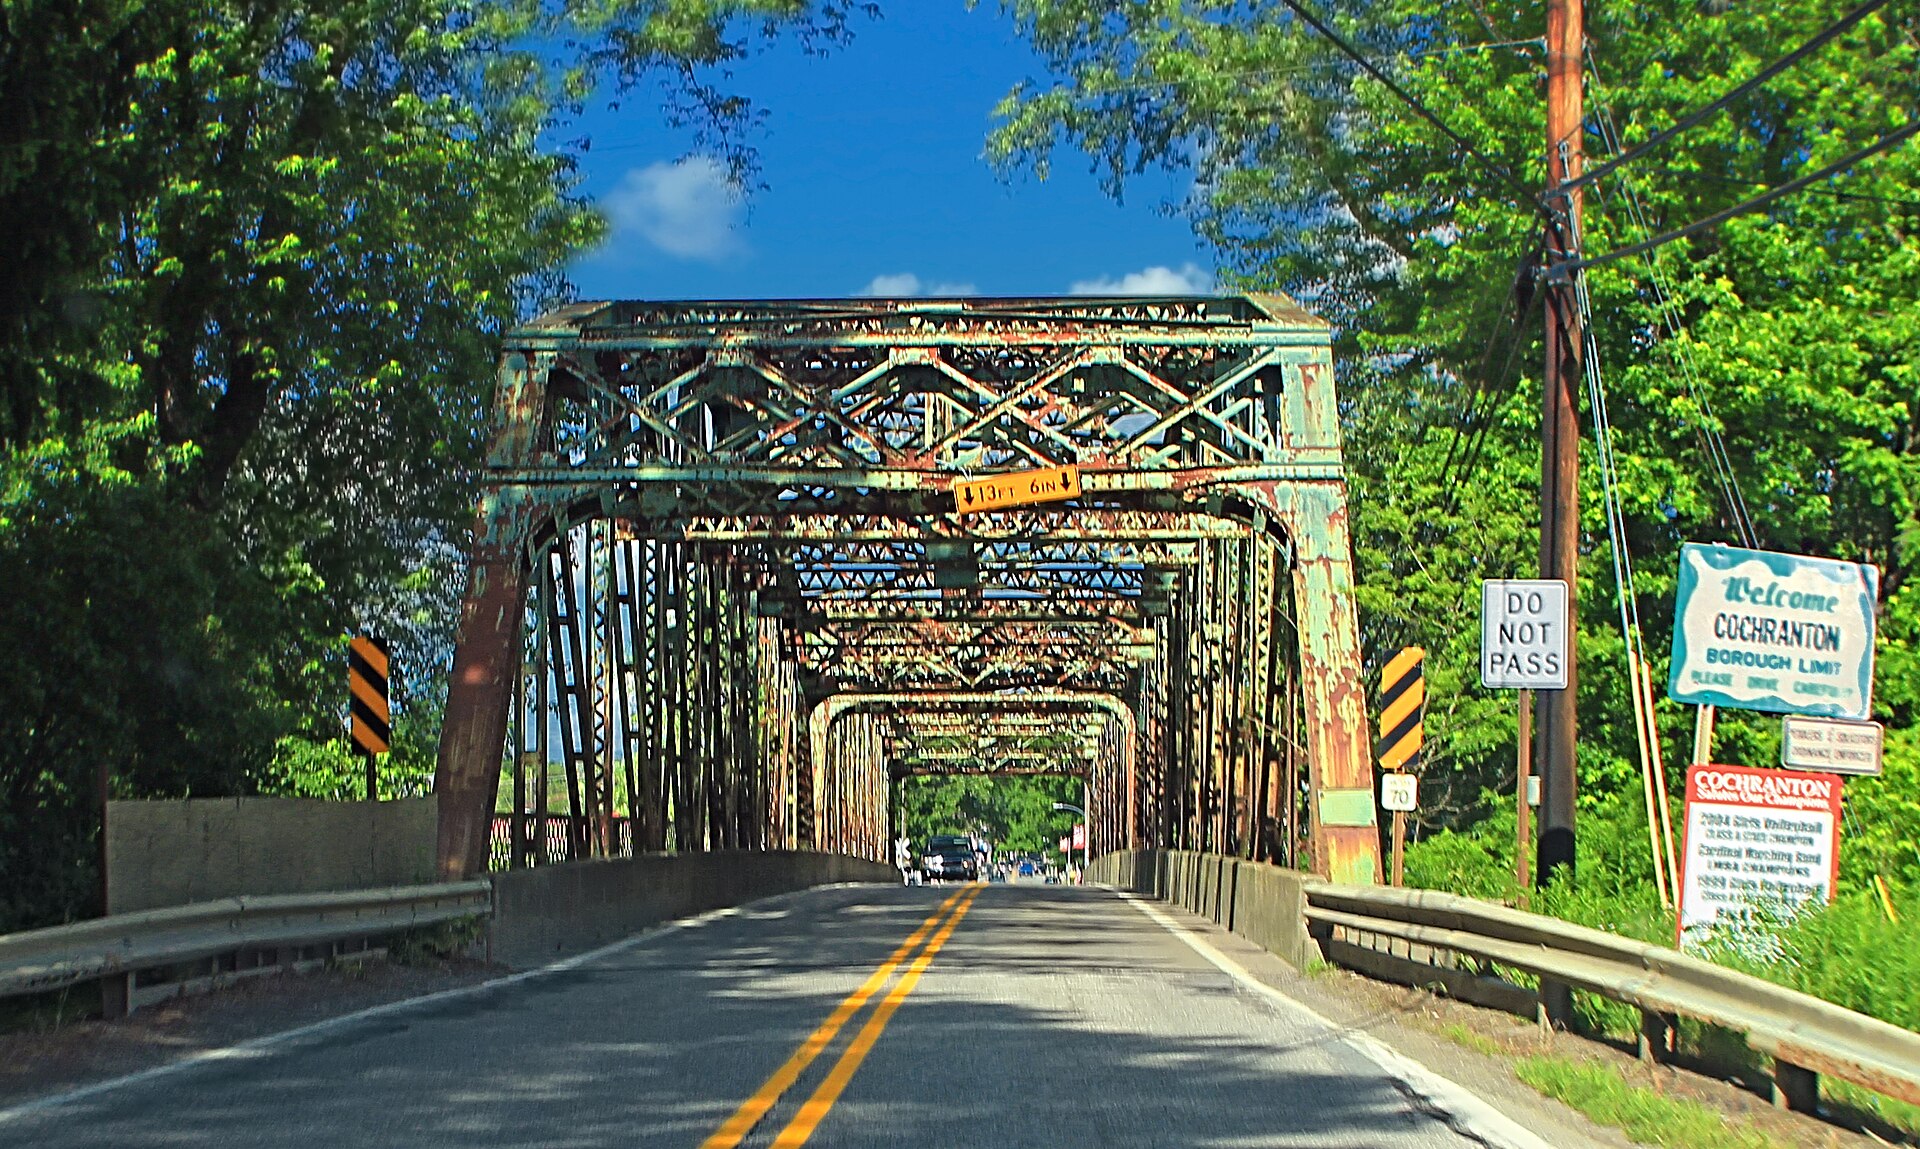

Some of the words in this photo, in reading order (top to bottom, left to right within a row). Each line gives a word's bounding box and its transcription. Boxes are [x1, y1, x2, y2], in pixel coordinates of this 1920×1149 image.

[1030, 478, 1056, 495] 6IN
[1508, 592, 1542, 614] DO
[1722, 576, 1840, 613] Welcome
[1499, 622, 1551, 645] NOT
[1714, 612, 1841, 651] COCHRANTON
[1490, 652, 1559, 675] PASS
[1706, 648, 1791, 670] BOROUGH
[1799, 658, 1843, 675] LIMIT
[1694, 771, 1832, 798] COCHRANTON
